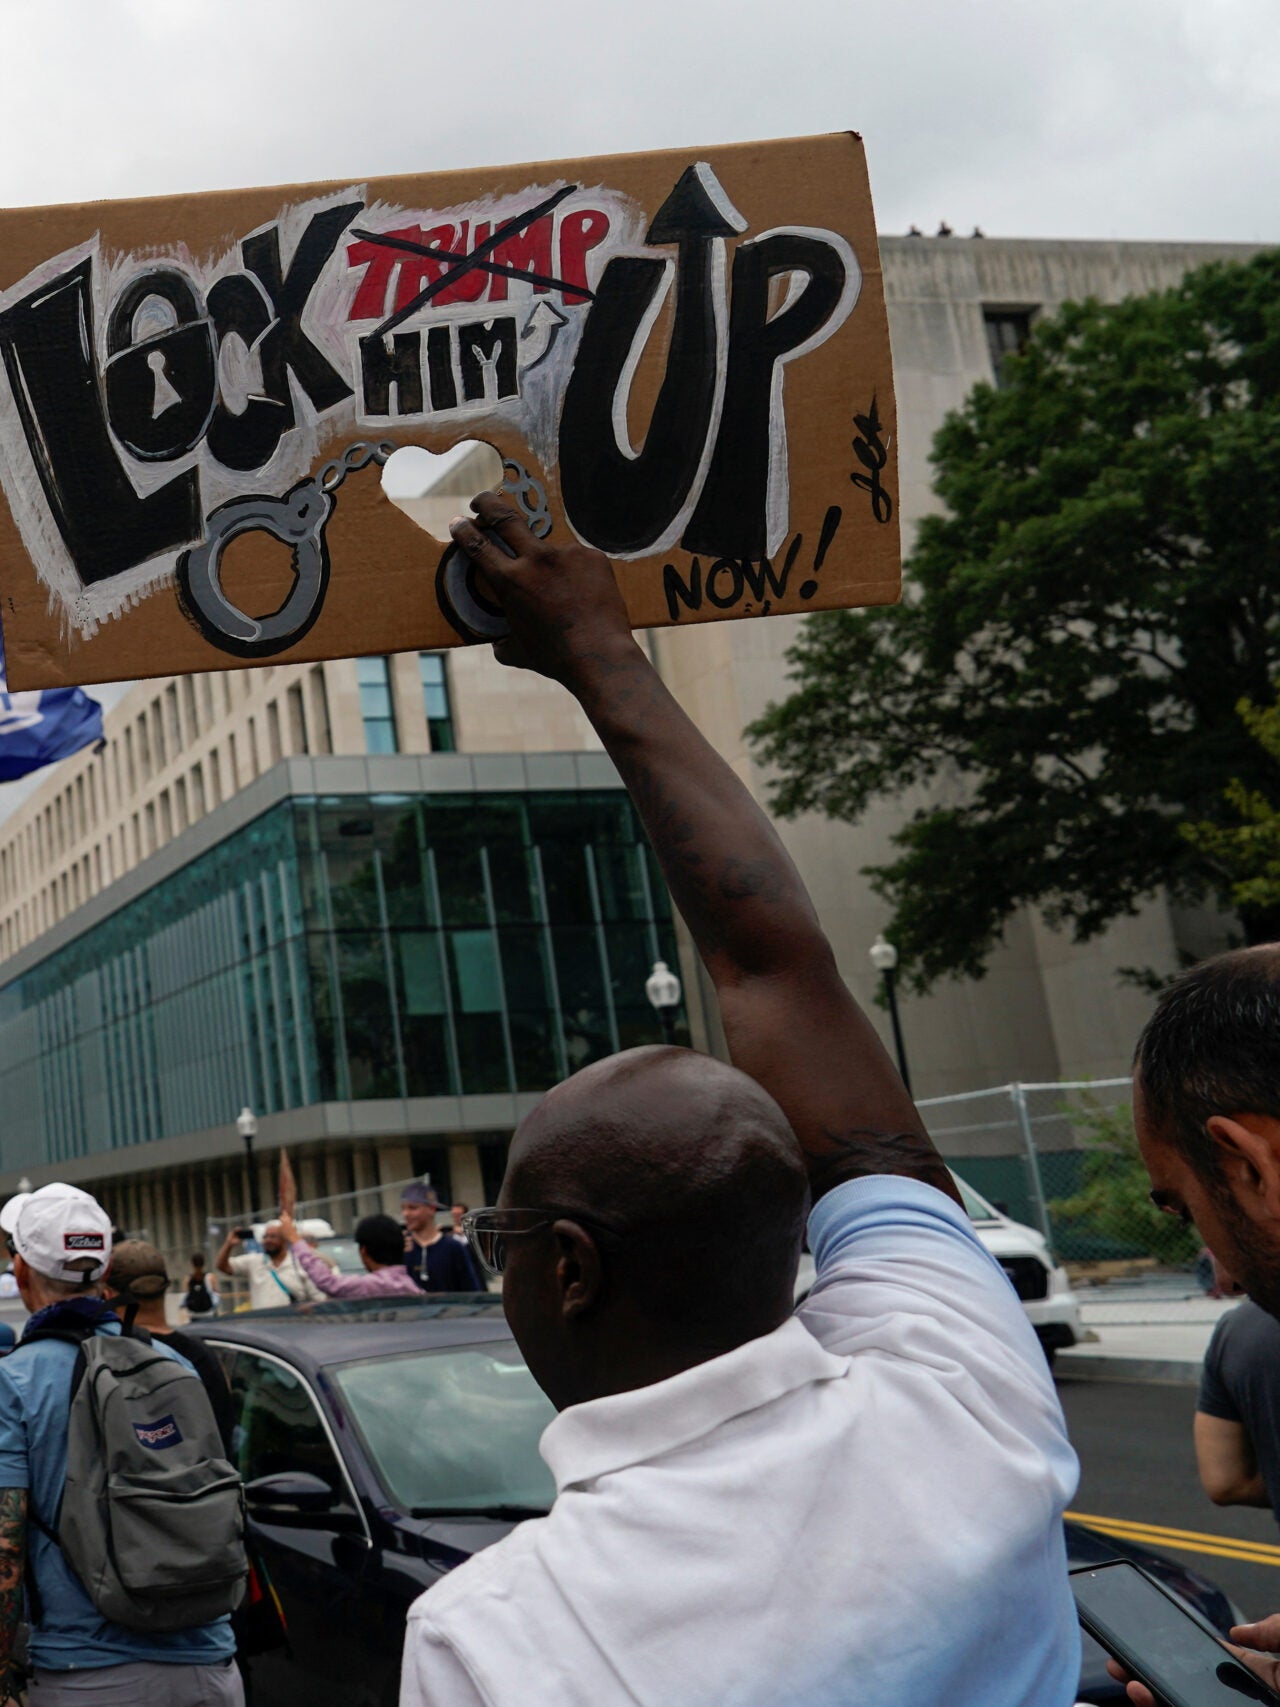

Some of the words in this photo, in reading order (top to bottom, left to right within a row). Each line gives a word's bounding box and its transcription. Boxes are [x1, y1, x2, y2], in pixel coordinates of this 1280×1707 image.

[347, 209, 609, 322] TRUMP
[360, 317, 518, 416] HIM
[558, 163, 858, 562] UP
[663, 505, 841, 621] NOW!
